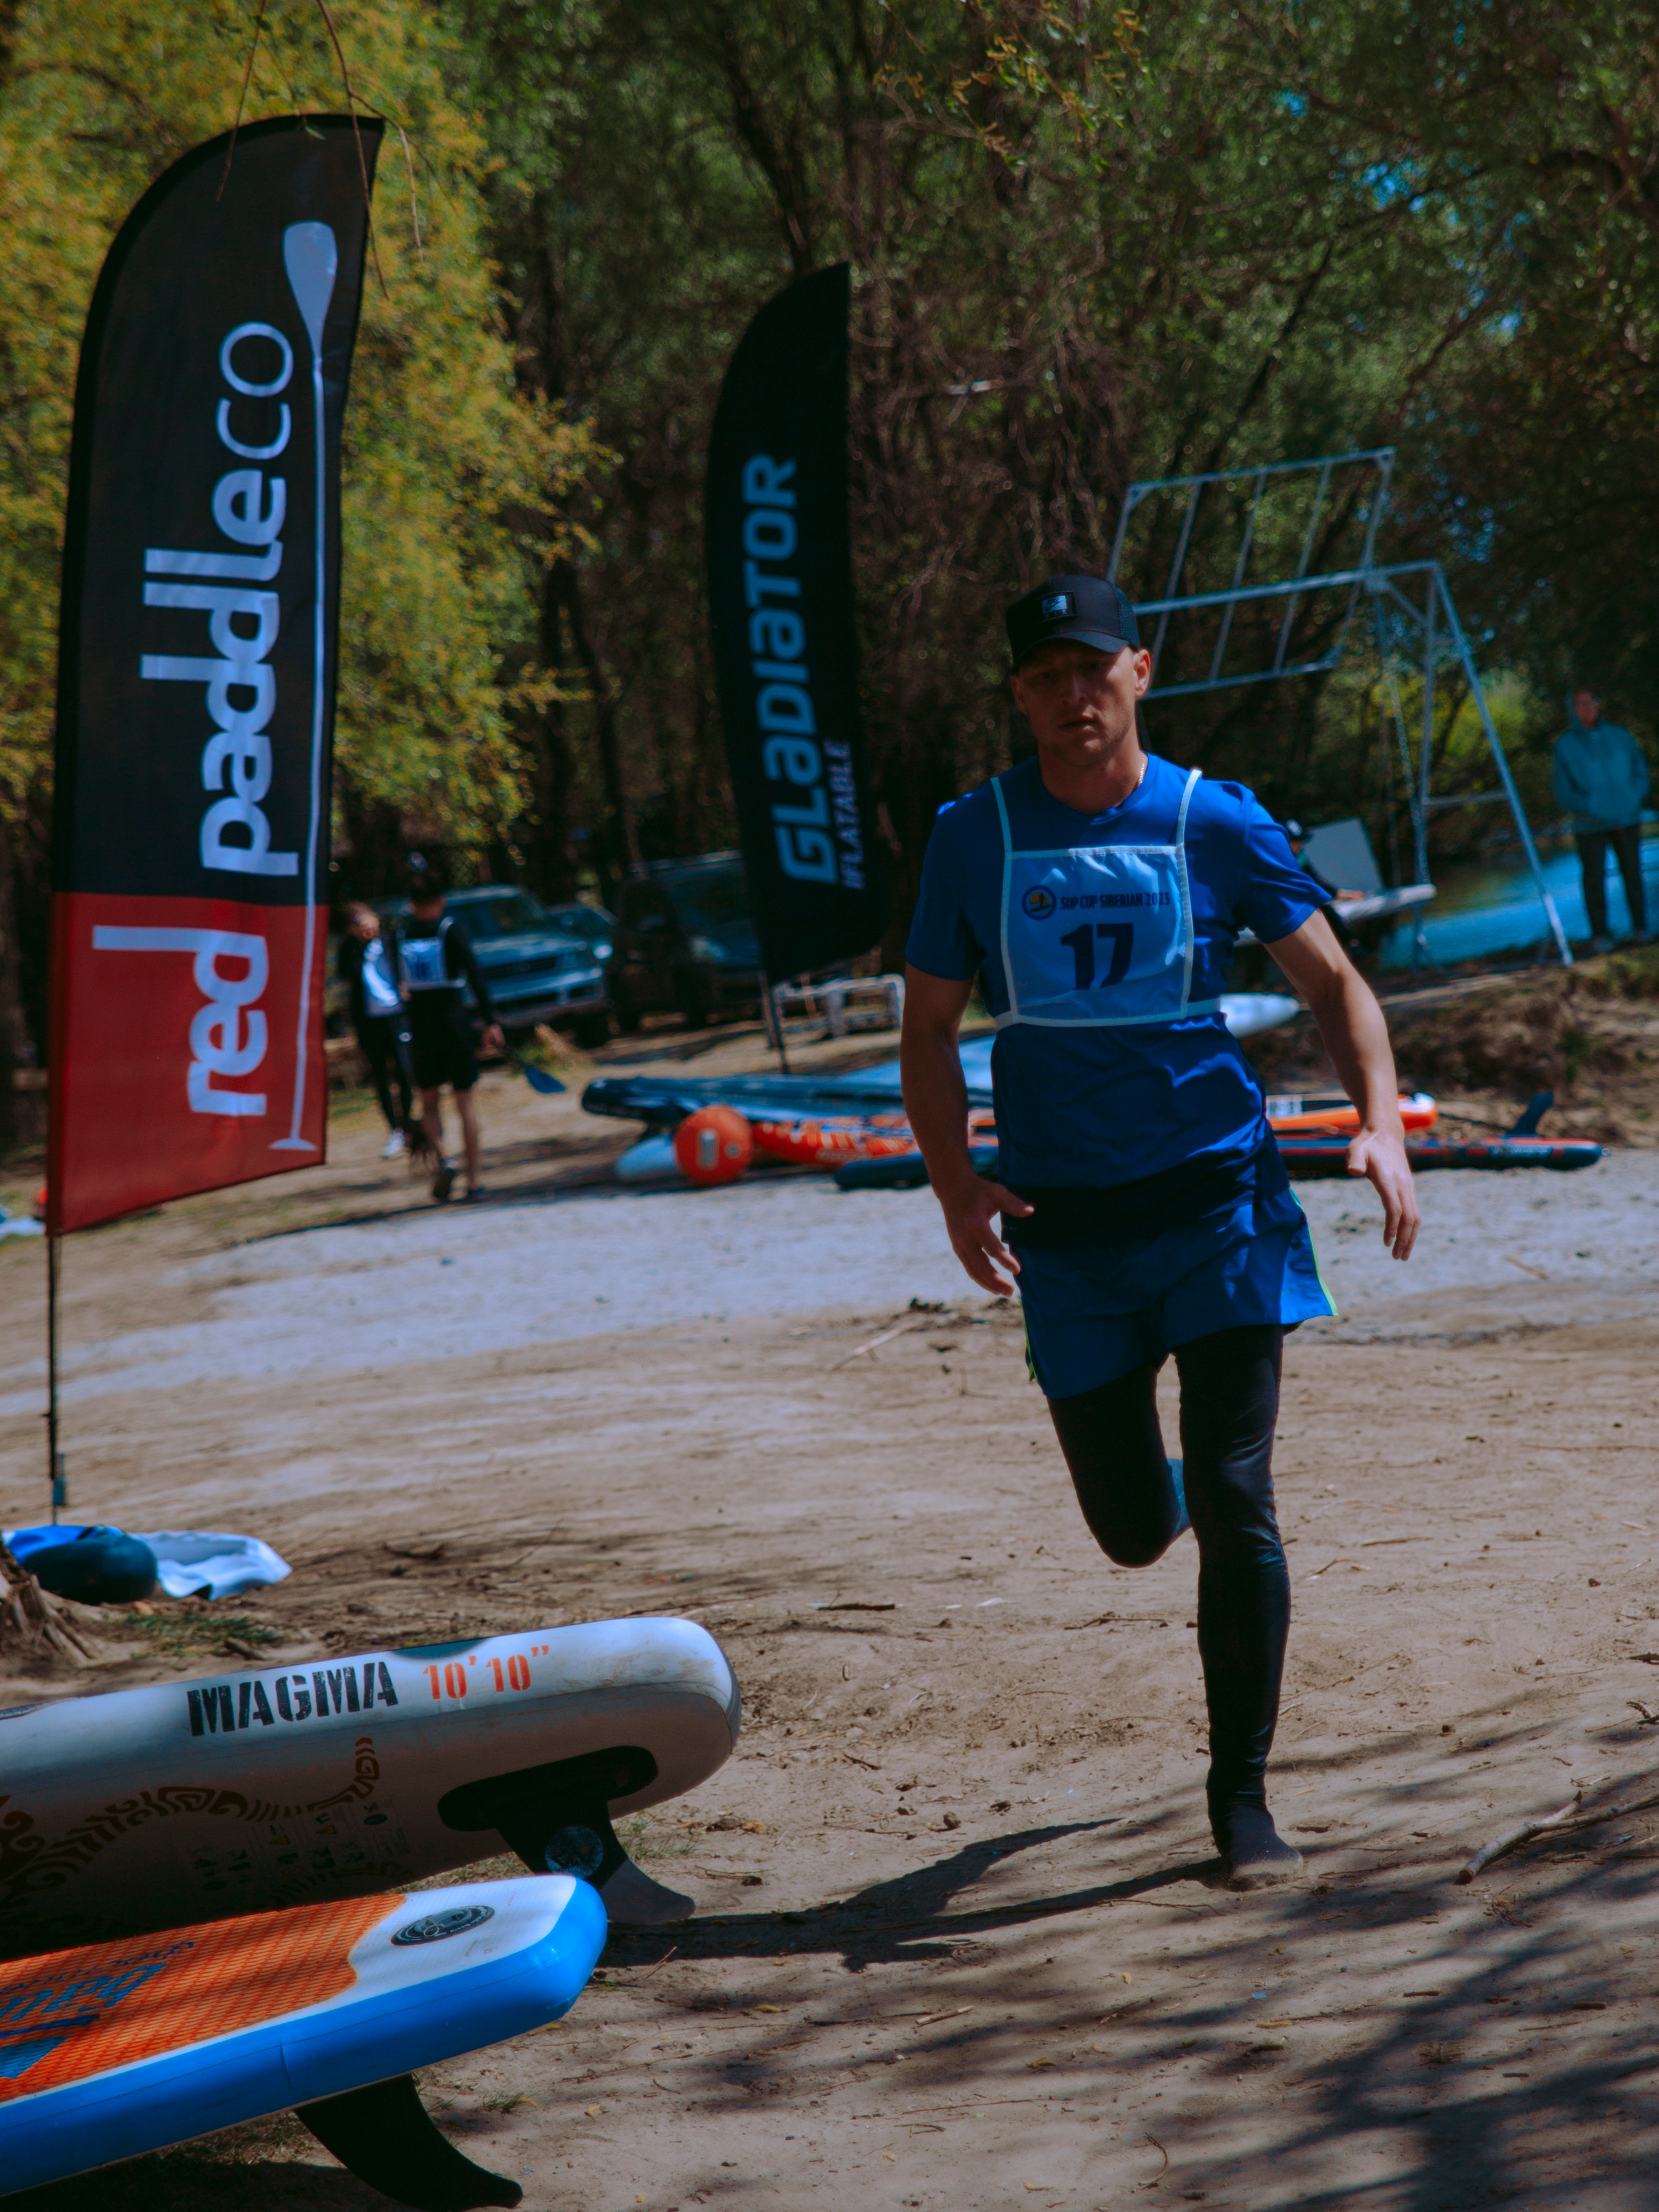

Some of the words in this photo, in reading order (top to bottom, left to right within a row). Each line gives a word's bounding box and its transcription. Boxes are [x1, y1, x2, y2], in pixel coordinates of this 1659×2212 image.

[1060, 897, 1079, 910] SUP
[1080, 896, 1098, 909] CUP
[1099, 893, 1143, 908] SIBERIAN
[1145, 892, 1170, 906] 2023
[1060, 923, 1134, 990] 17
[92, 925, 269, 1117] red
[187, 1661, 399, 1737] MAGMA
